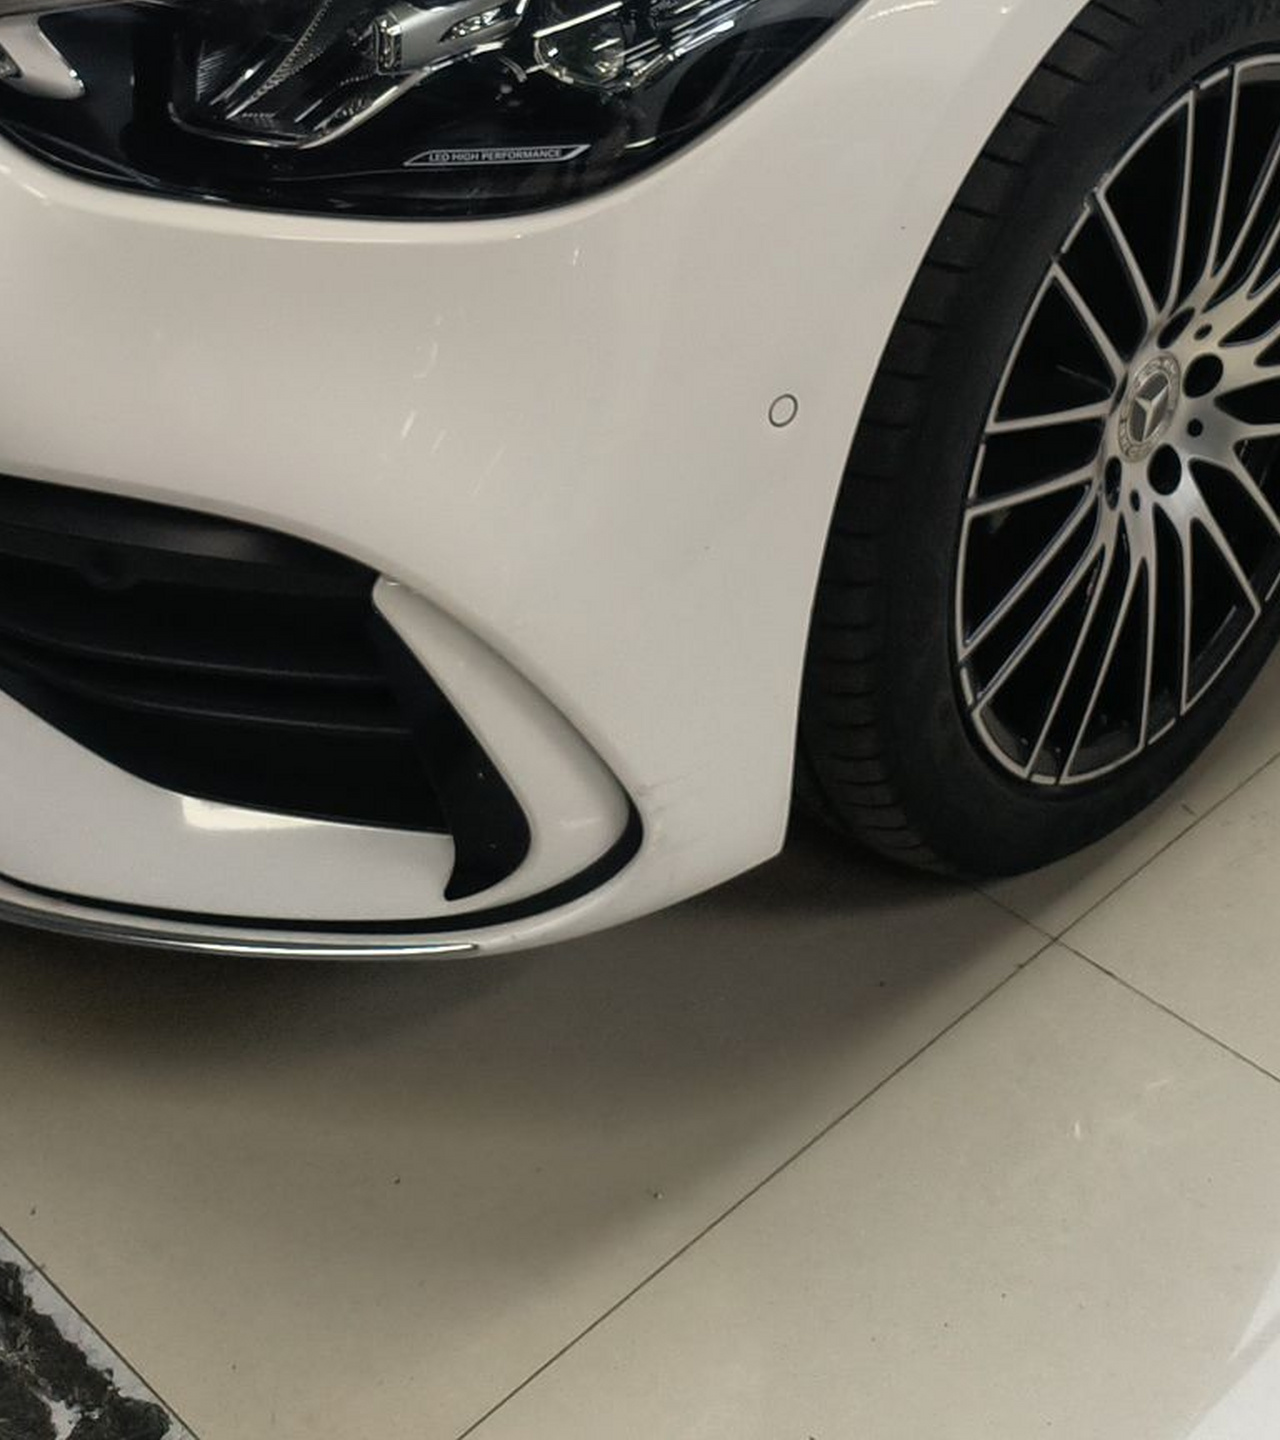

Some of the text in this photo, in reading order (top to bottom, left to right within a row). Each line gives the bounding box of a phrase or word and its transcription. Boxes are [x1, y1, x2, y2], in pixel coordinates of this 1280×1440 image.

[428, 147, 563, 162] LED HIGH PERFORMANCE
